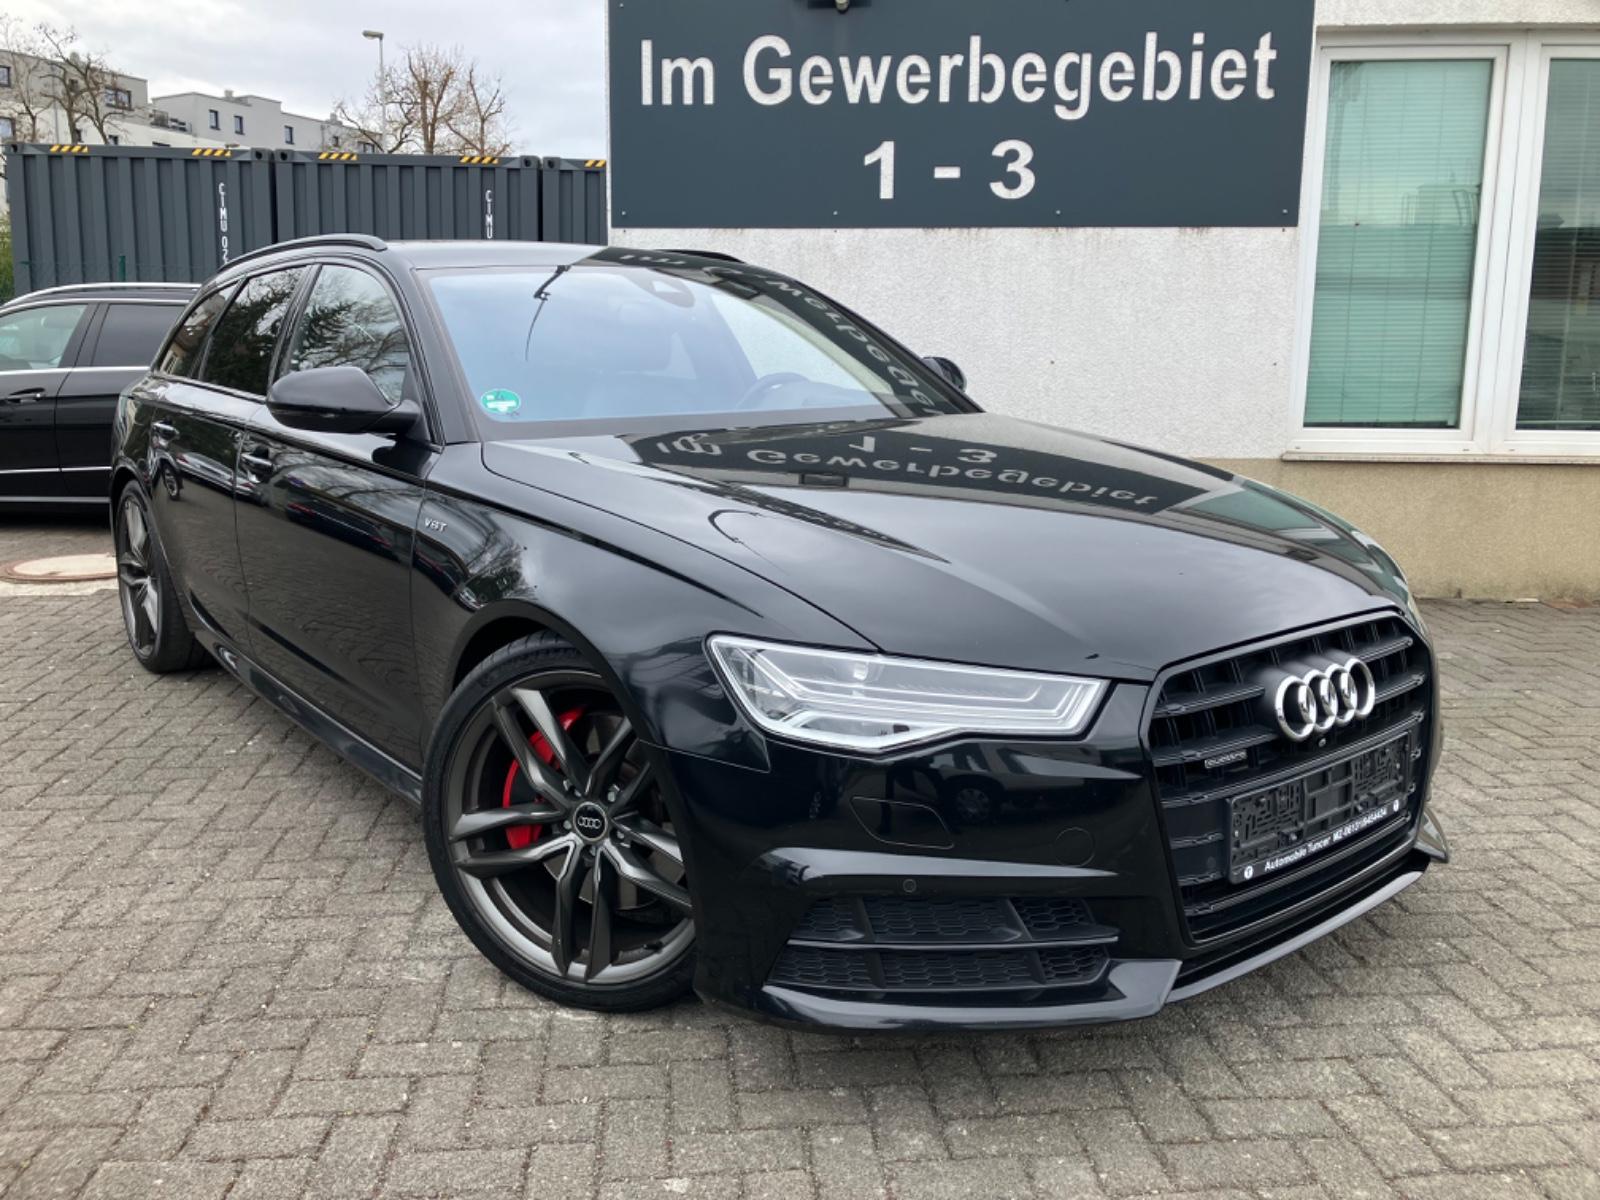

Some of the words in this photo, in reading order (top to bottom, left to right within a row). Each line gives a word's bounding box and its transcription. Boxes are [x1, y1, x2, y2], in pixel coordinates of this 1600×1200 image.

[641, 39, 715, 105] Im
[742, 32, 1277, 121] Gewerbegebiet
[864, 140, 895, 200] 1
[933, 165, 961, 179] -
[989, 139, 1036, 200] 3
[485, 190, 493, 239] CIMU
